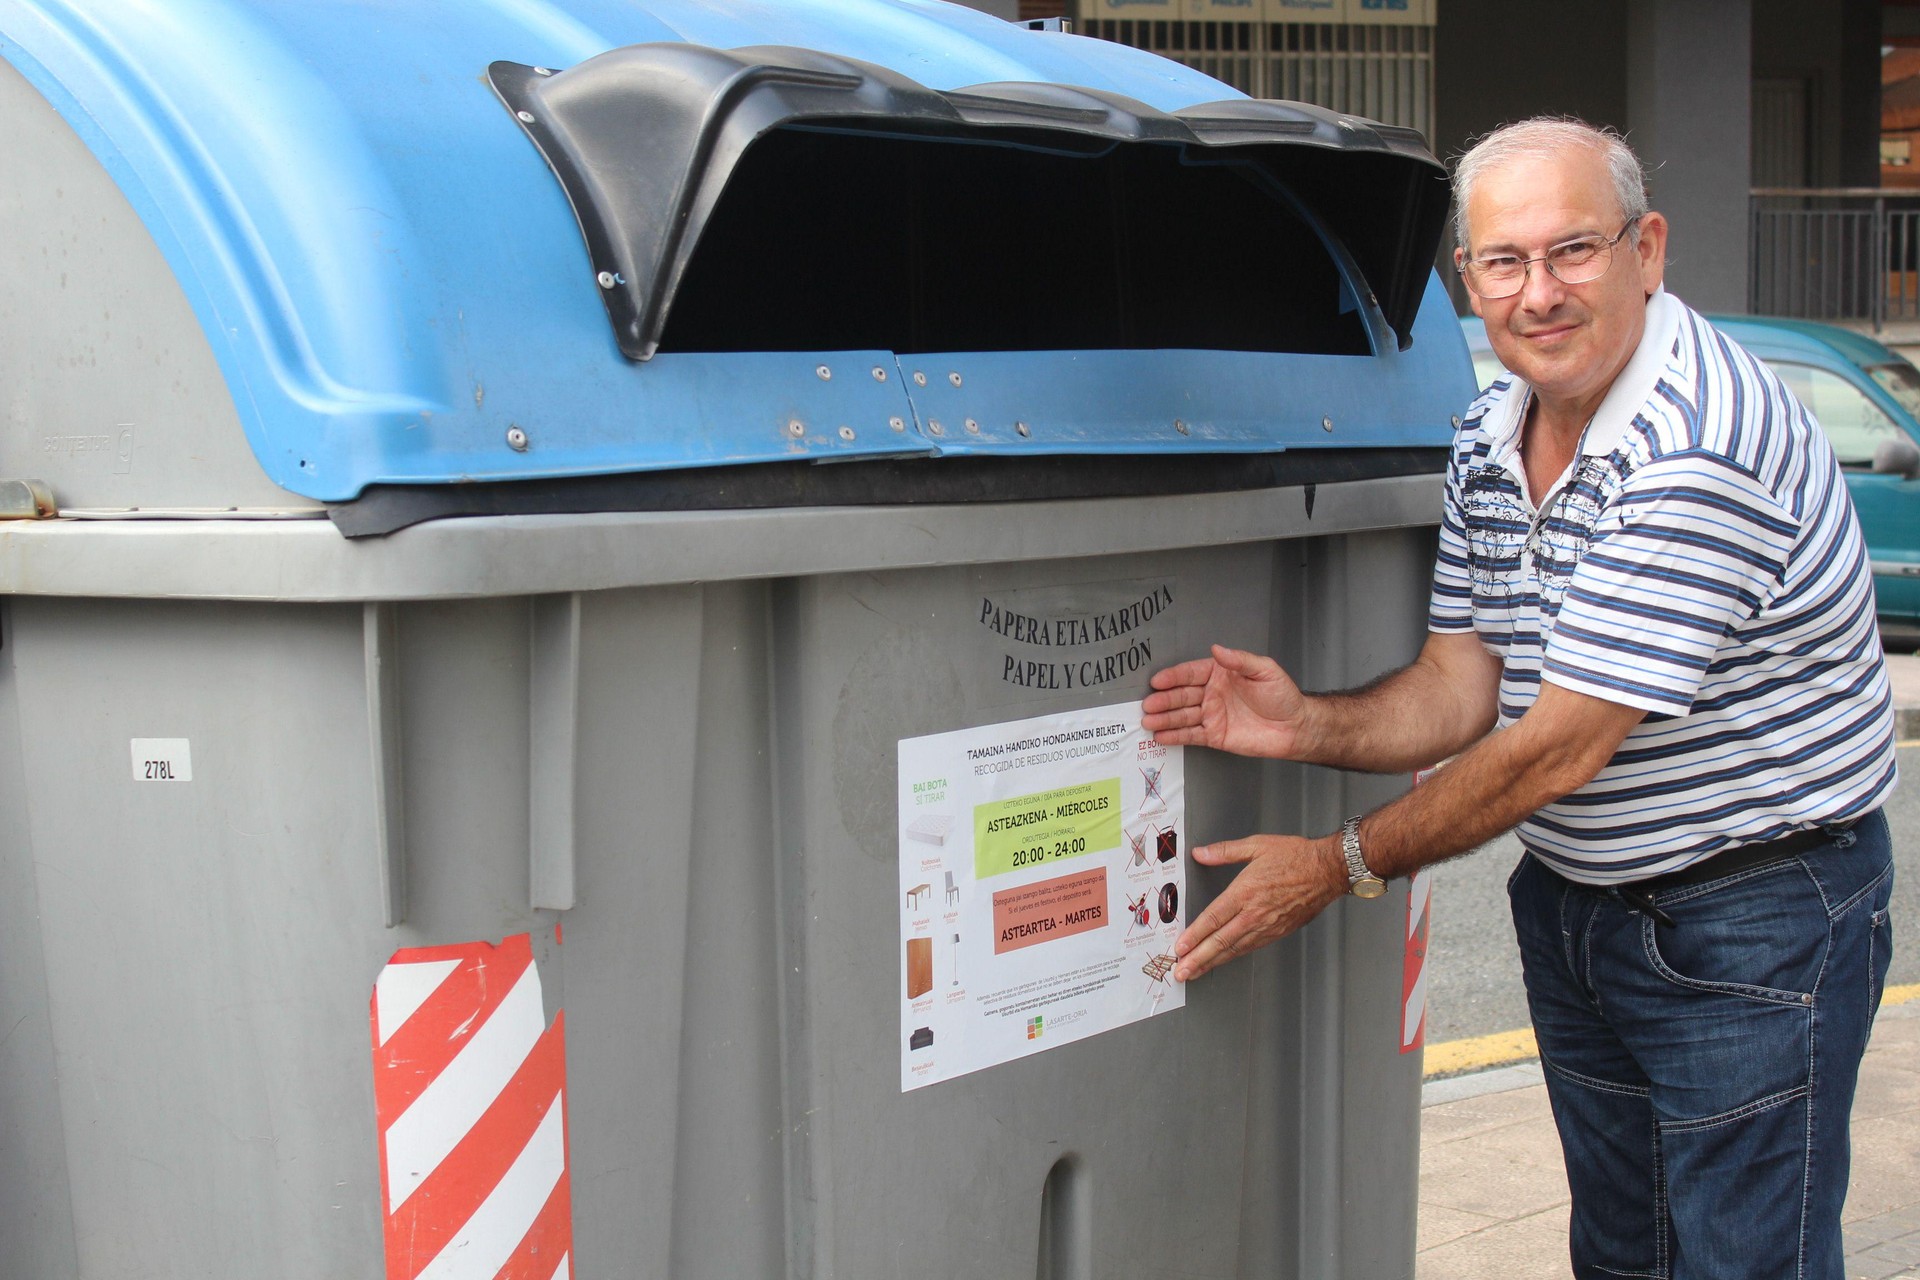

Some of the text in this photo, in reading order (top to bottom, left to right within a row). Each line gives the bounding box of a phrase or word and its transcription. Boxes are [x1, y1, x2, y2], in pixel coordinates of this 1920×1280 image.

[980, 584, 1174, 646] PAPERA ETA KARTOIA
[1002, 638, 1152, 690] PAPEL Y CARTÓN
[967, 724, 1126, 760] TAMAINA HANDIKO HONDAKINEN BILKETA
[1139, 742, 1146, 750] EZ
[974, 741, 1120, 776] RECOGIDA DE RESIDUOS VOLUMINOSOS
[1137, 748, 1166, 761] NO TIRAR
[145, 760, 174, 779] 278L
[914, 779, 947, 792] BAI BOTA
[924, 792, 944, 803] TIRAR
[1004, 800, 1022, 808] UZTEKO
[1024, 796, 1040, 805] EGUNA
[1053, 790, 1066, 799] PARA
[1066, 786, 1092, 798] DEPOSITAR
[987, 810, 1048, 833] ASTEAZKENA
[1056, 797, 1108, 818] MIÉRCOLES
[1022, 832, 1050, 844] ORDUTEGIA
[1054, 827, 1075, 837] HORARIO
[1012, 846, 1044, 866] 20:00
[1055, 838, 1085, 856] 24:00
[1002, 918, 1056, 942] ASTEARTEA
[1066, 906, 1102, 926] MARTES
[1046, 1008, 1088, 1026] LASARTE-ORIA
